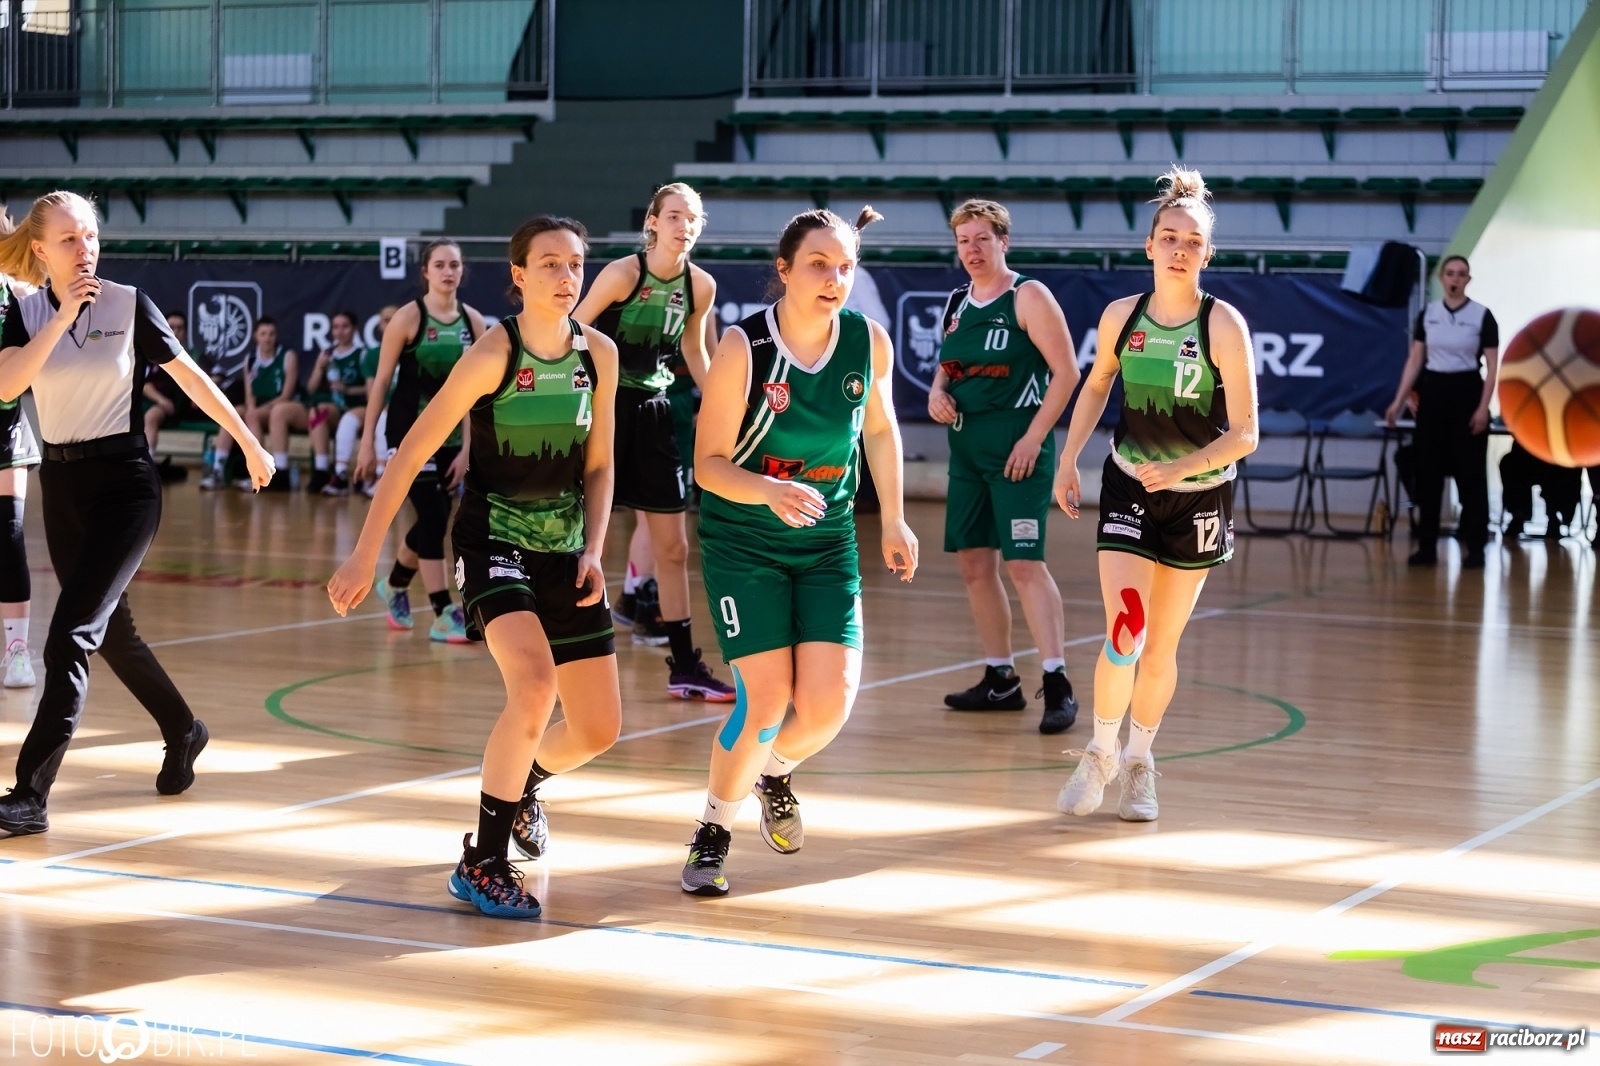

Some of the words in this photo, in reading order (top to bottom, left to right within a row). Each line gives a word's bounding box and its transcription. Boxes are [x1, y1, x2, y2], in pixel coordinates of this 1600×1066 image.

[385, 247, 402, 268] B
[662, 306, 686, 336] 17
[984, 328, 1010, 351] 10
[1173, 360, 1203, 399] 12
[576, 392, 593, 432] 4
[1124, 514, 1142, 525] FELIX
[1193, 516, 1220, 553] 12
[720, 595, 741, 638] 9
